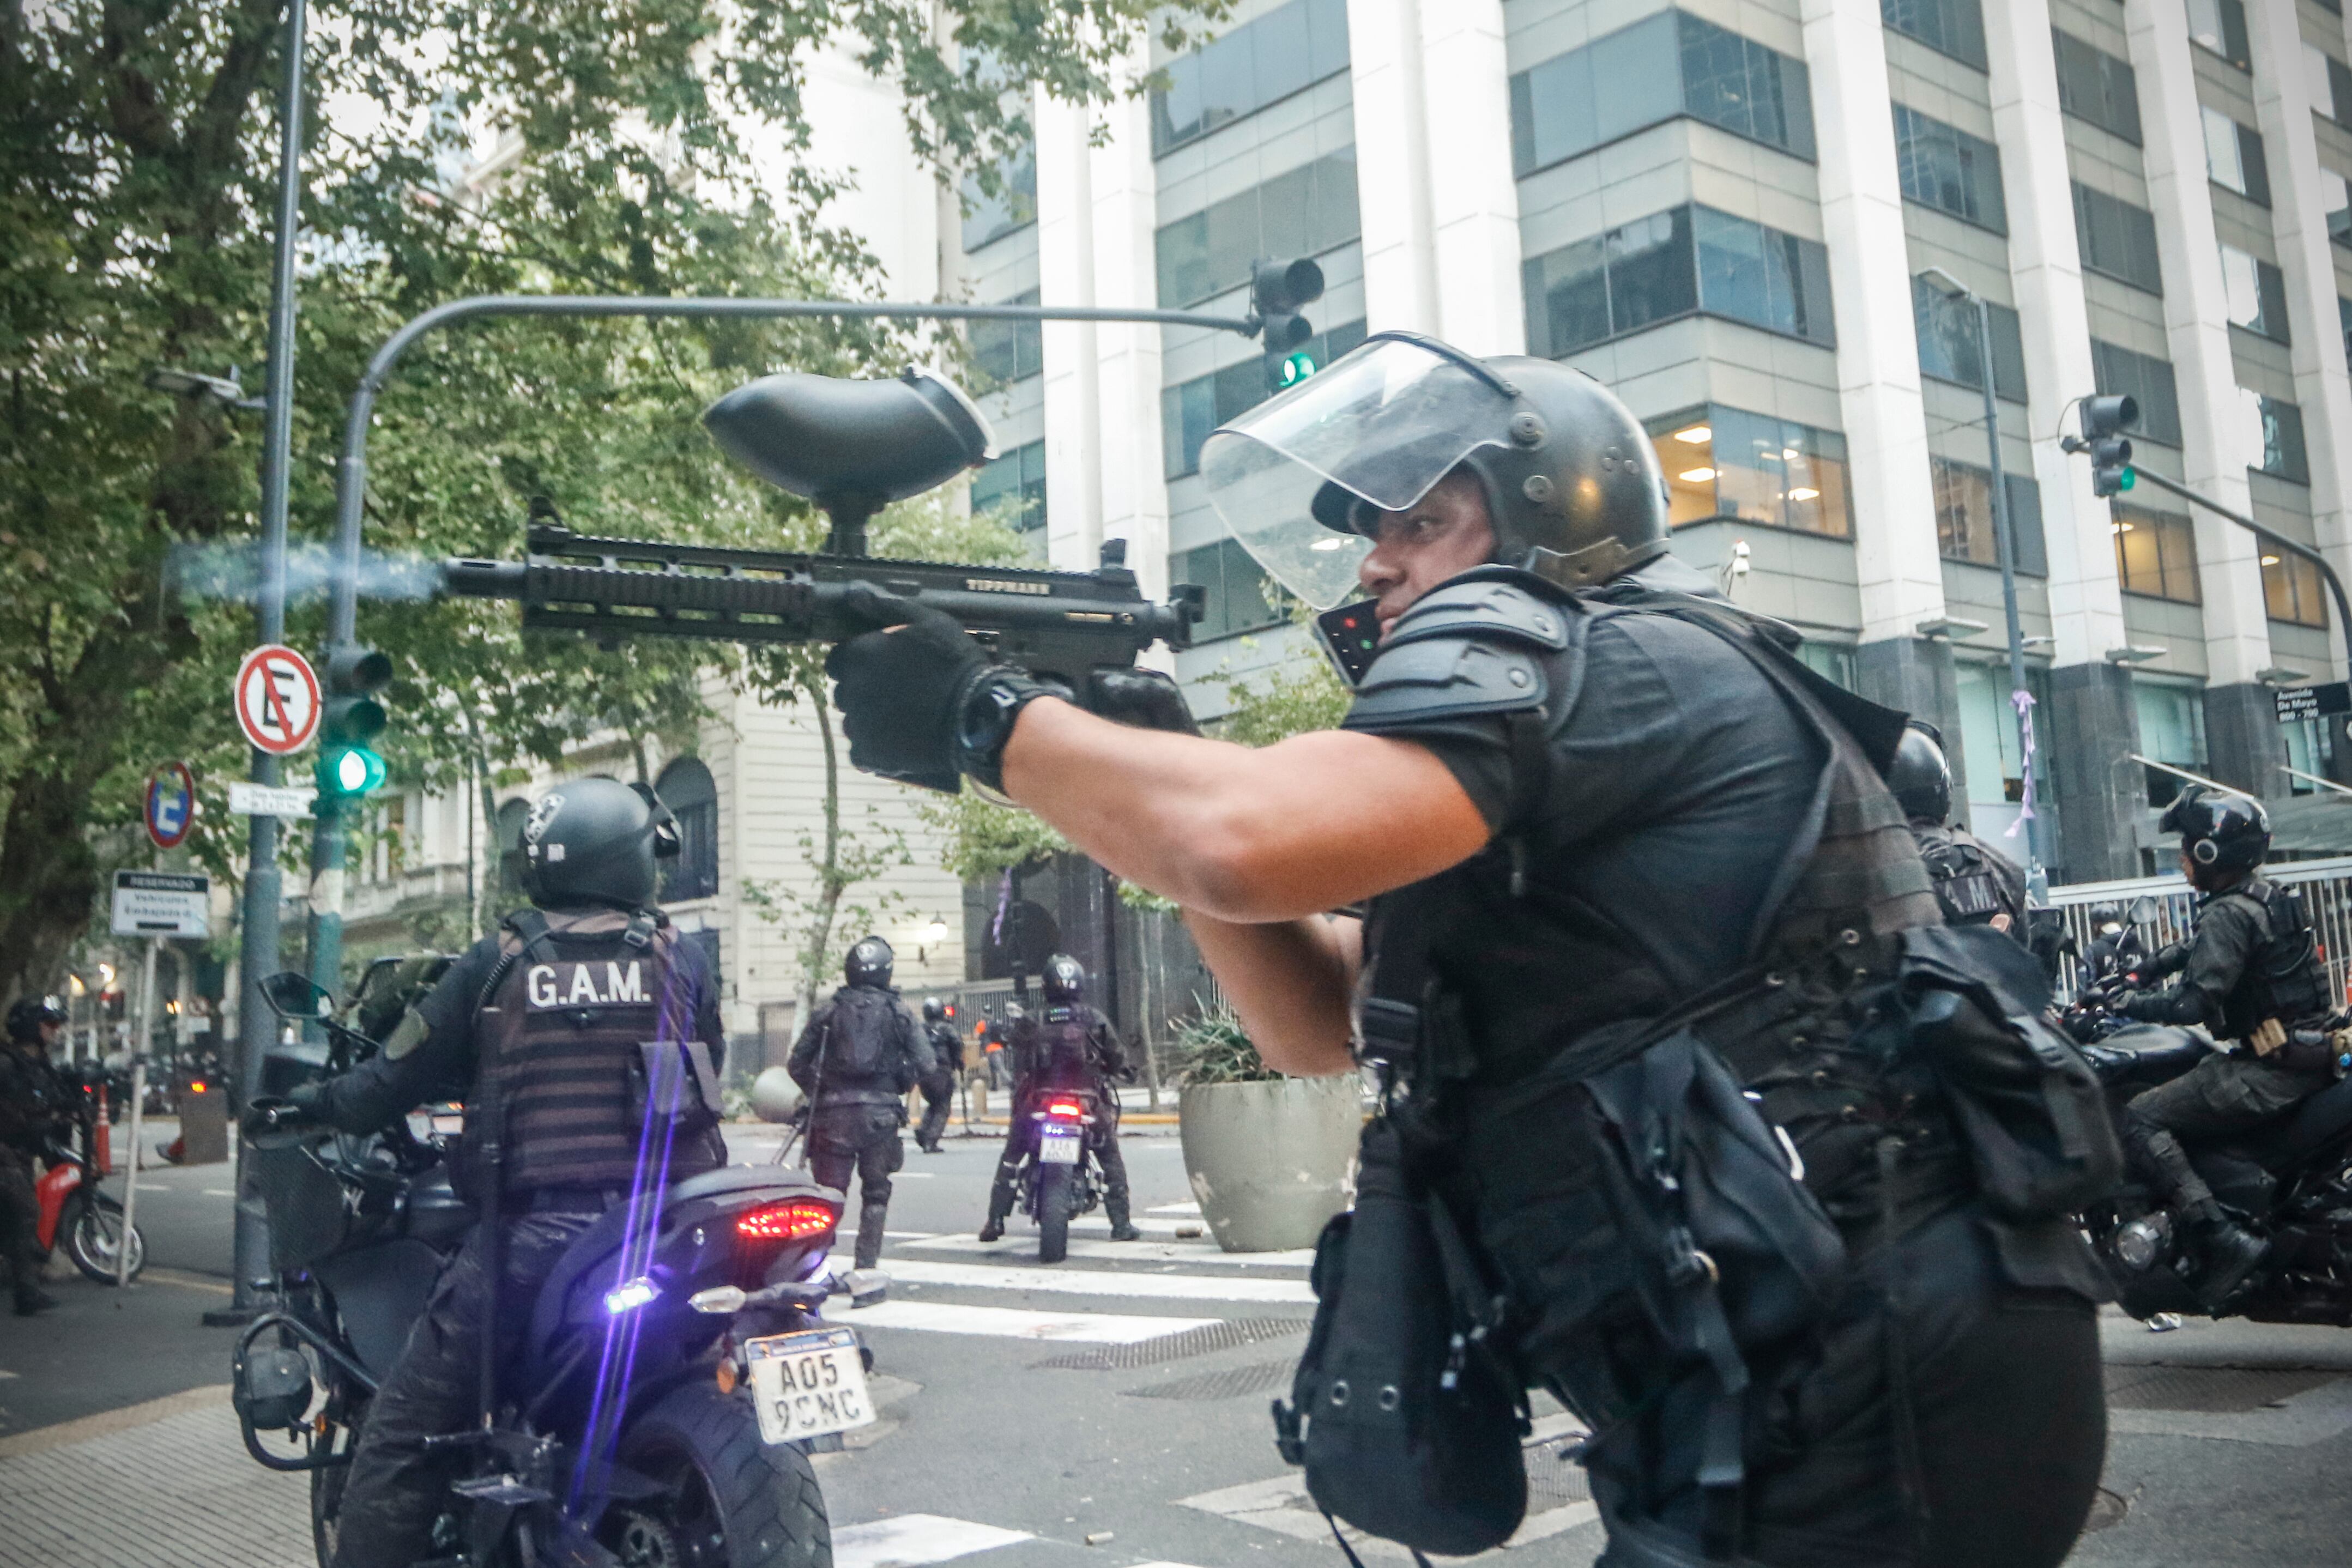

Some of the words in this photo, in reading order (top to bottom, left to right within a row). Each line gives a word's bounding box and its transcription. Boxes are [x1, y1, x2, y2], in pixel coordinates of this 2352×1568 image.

[262, 669, 295, 728] E
[2277, 688, 2313, 700] Avenida
[2277, 700, 2290, 711] De
[2291, 698, 2317, 709] Mayo
[528, 961, 651, 1008] G.A.M.
[781, 1354, 838, 1394] A05
[775, 1388, 860, 1434] 9CNC
